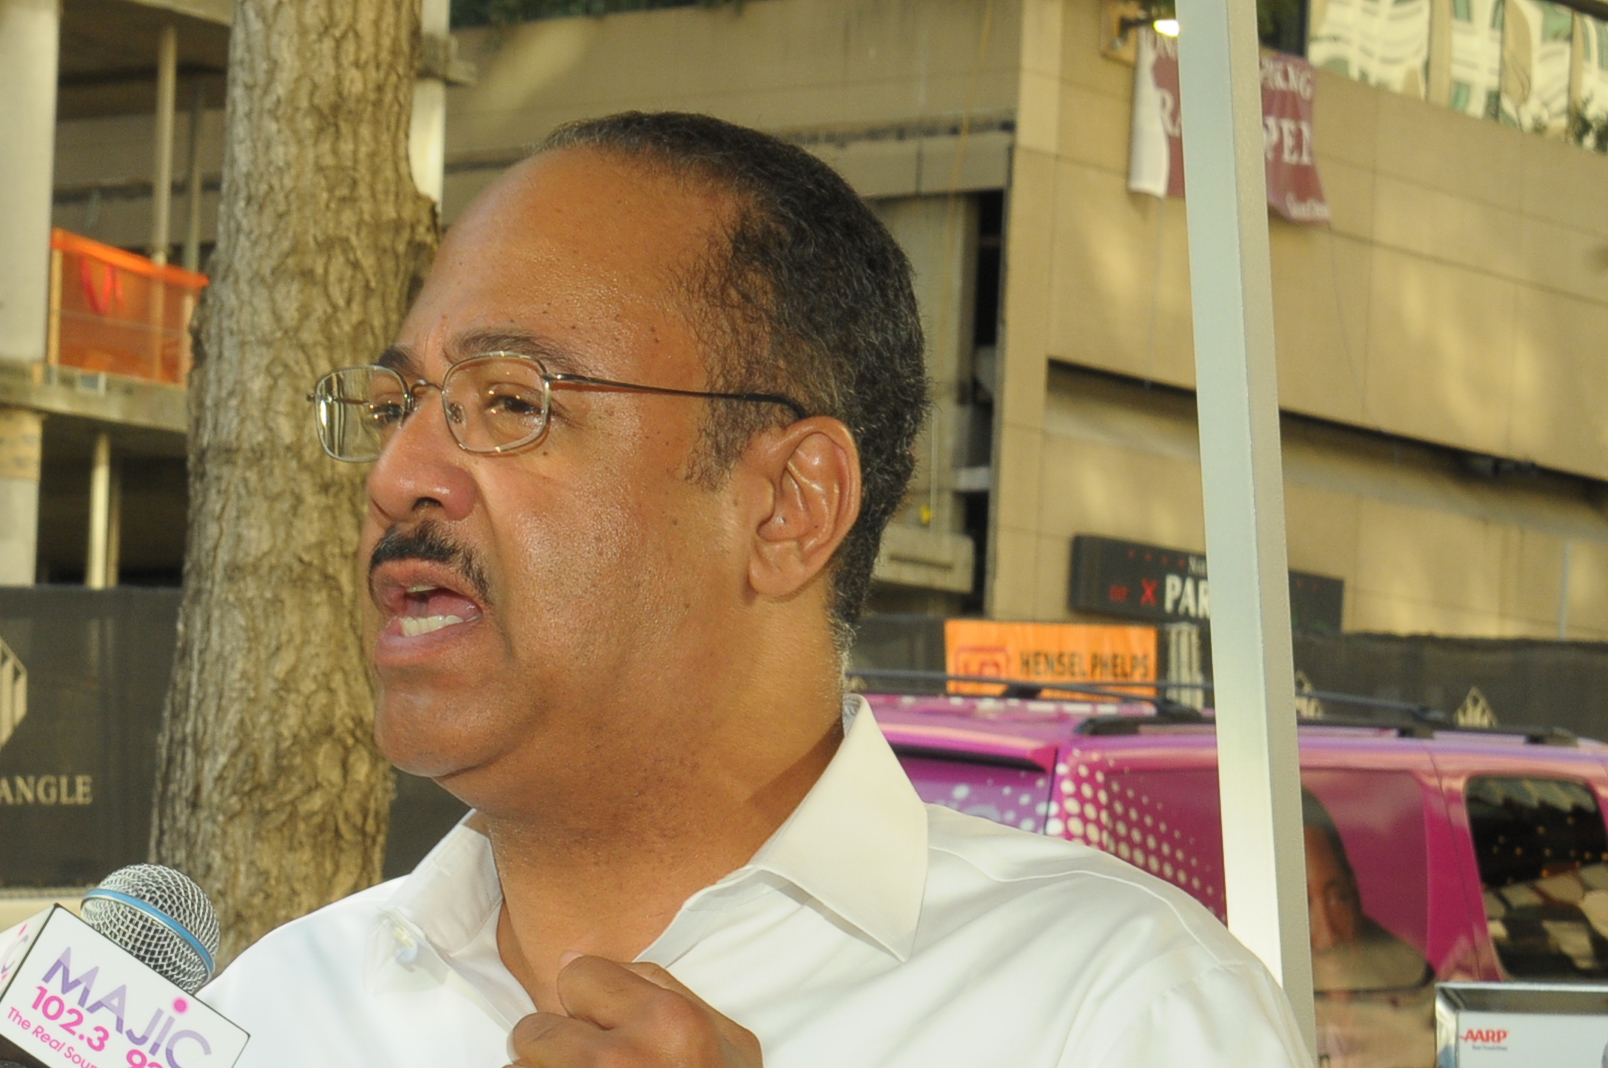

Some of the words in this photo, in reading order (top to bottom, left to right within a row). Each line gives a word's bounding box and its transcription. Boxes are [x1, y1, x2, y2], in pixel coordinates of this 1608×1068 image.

[7, 1006, 31, 1031] The
[31, 1025, 66, 1052] Real
[31, 985, 110, 1052] 102.3
[1459, 1029, 1509, 1043] AARP
